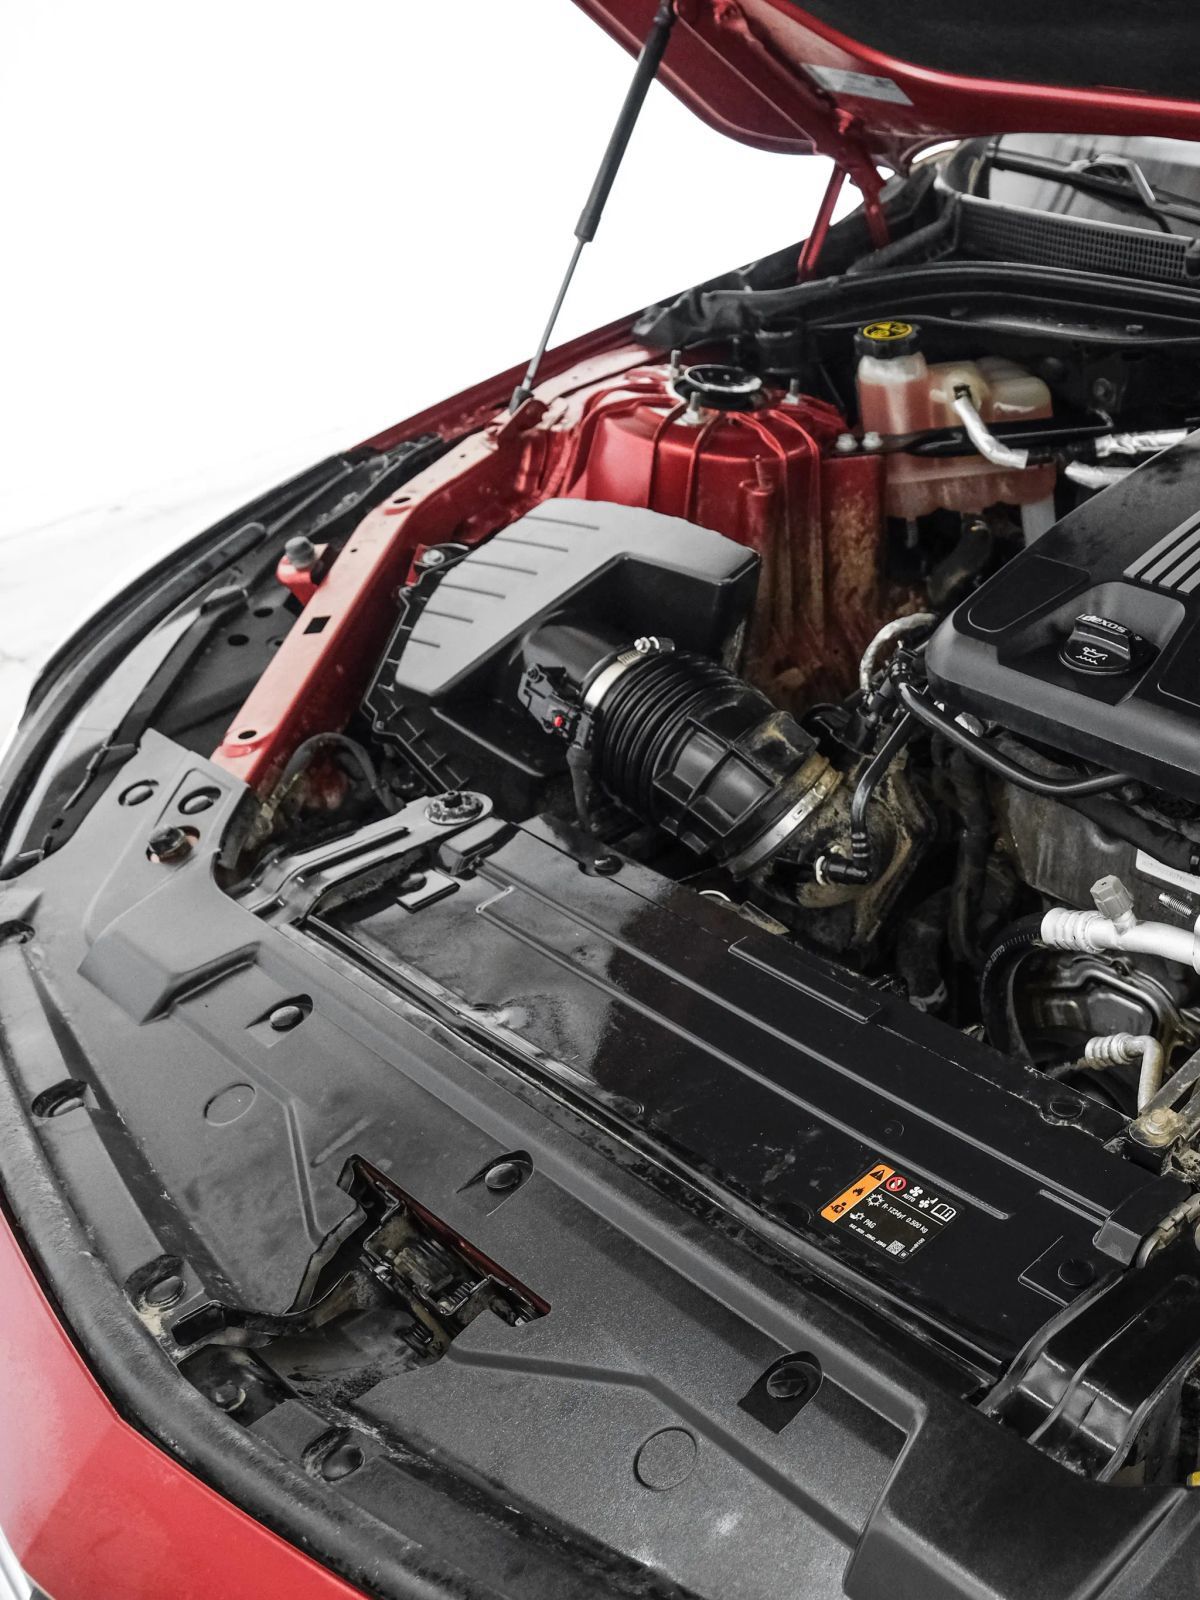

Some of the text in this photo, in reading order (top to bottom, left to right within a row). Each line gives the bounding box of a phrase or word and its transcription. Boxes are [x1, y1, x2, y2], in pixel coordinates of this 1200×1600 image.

[1081, 615, 1128, 633] dexos
[902, 1193, 916, 1202] AUTO
[863, 1218, 877, 1229] PAG
[905, 1217, 922, 1229] 0.500
[920, 1225, 929, 1234] kg
